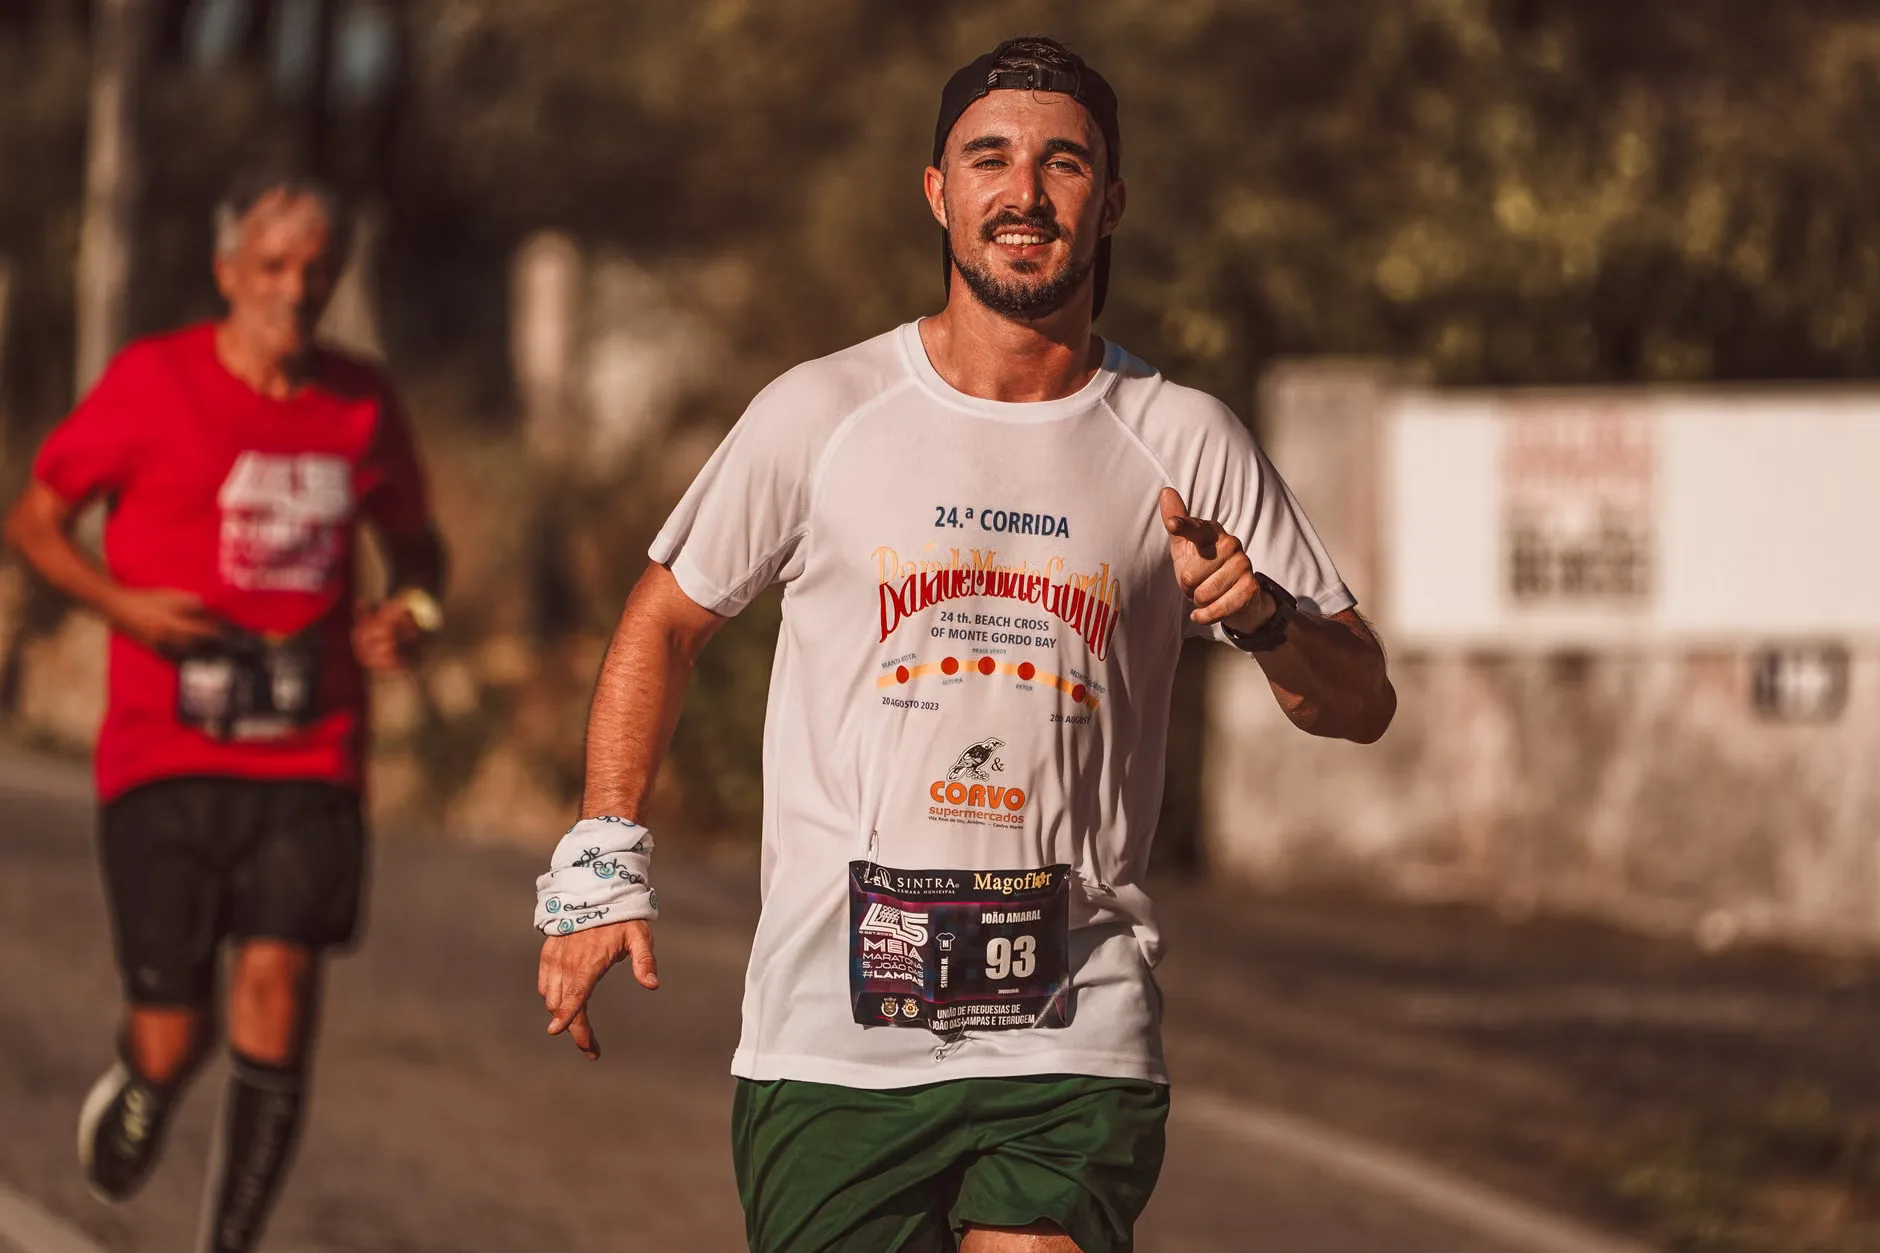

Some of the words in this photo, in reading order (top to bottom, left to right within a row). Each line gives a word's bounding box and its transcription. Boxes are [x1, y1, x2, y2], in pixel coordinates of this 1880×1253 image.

[980, 509, 1070, 538] CORRIDA
[940, 611, 954, 622] 24
[957, 612, 971, 624] th.
[975, 615, 1010, 627] BEACH
[1014, 618, 1049, 631] CROSS
[931, 627, 945, 637] OF
[948, 629, 988, 642] MONTE
[991, 633, 1032, 645] GORDO
[1035, 637, 1057, 649] BAY
[882, 696, 890, 705] 20
[891, 699, 919, 709] AGOSTO
[921, 701, 940, 711] 2023
[930, 780, 1026, 812] CORVO
[929, 806, 1024, 824] supermercados
[897, 877, 955, 889] SINTRA
[981, 911, 1005, 924] JOÃO
[1006, 909, 1041, 924] AMARAL
[863, 937, 924, 963] MEIA
[942, 939, 949, 948] M
[862, 953, 924, 970] MARATONA
[985, 935, 1036, 980] 93
[862, 961, 873, 969] S.
[875, 961, 906, 971] JOÃO
[907, 967, 924, 979] DAS
[862, 970, 924, 987] #LAMPAS
[941, 965, 949, 989] SENIOR
[937, 1006, 956, 1019] UNIÃO
[957, 1006, 967, 1016] DE
[967, 1005, 1010, 1015] FREGUESIAS
[1011, 1004, 1021, 1014] DE
[949, 1018, 961, 1029] DAS
[991, 1016, 997, 1026] E
[997, 1014, 1035, 1026] TERRUGEM
